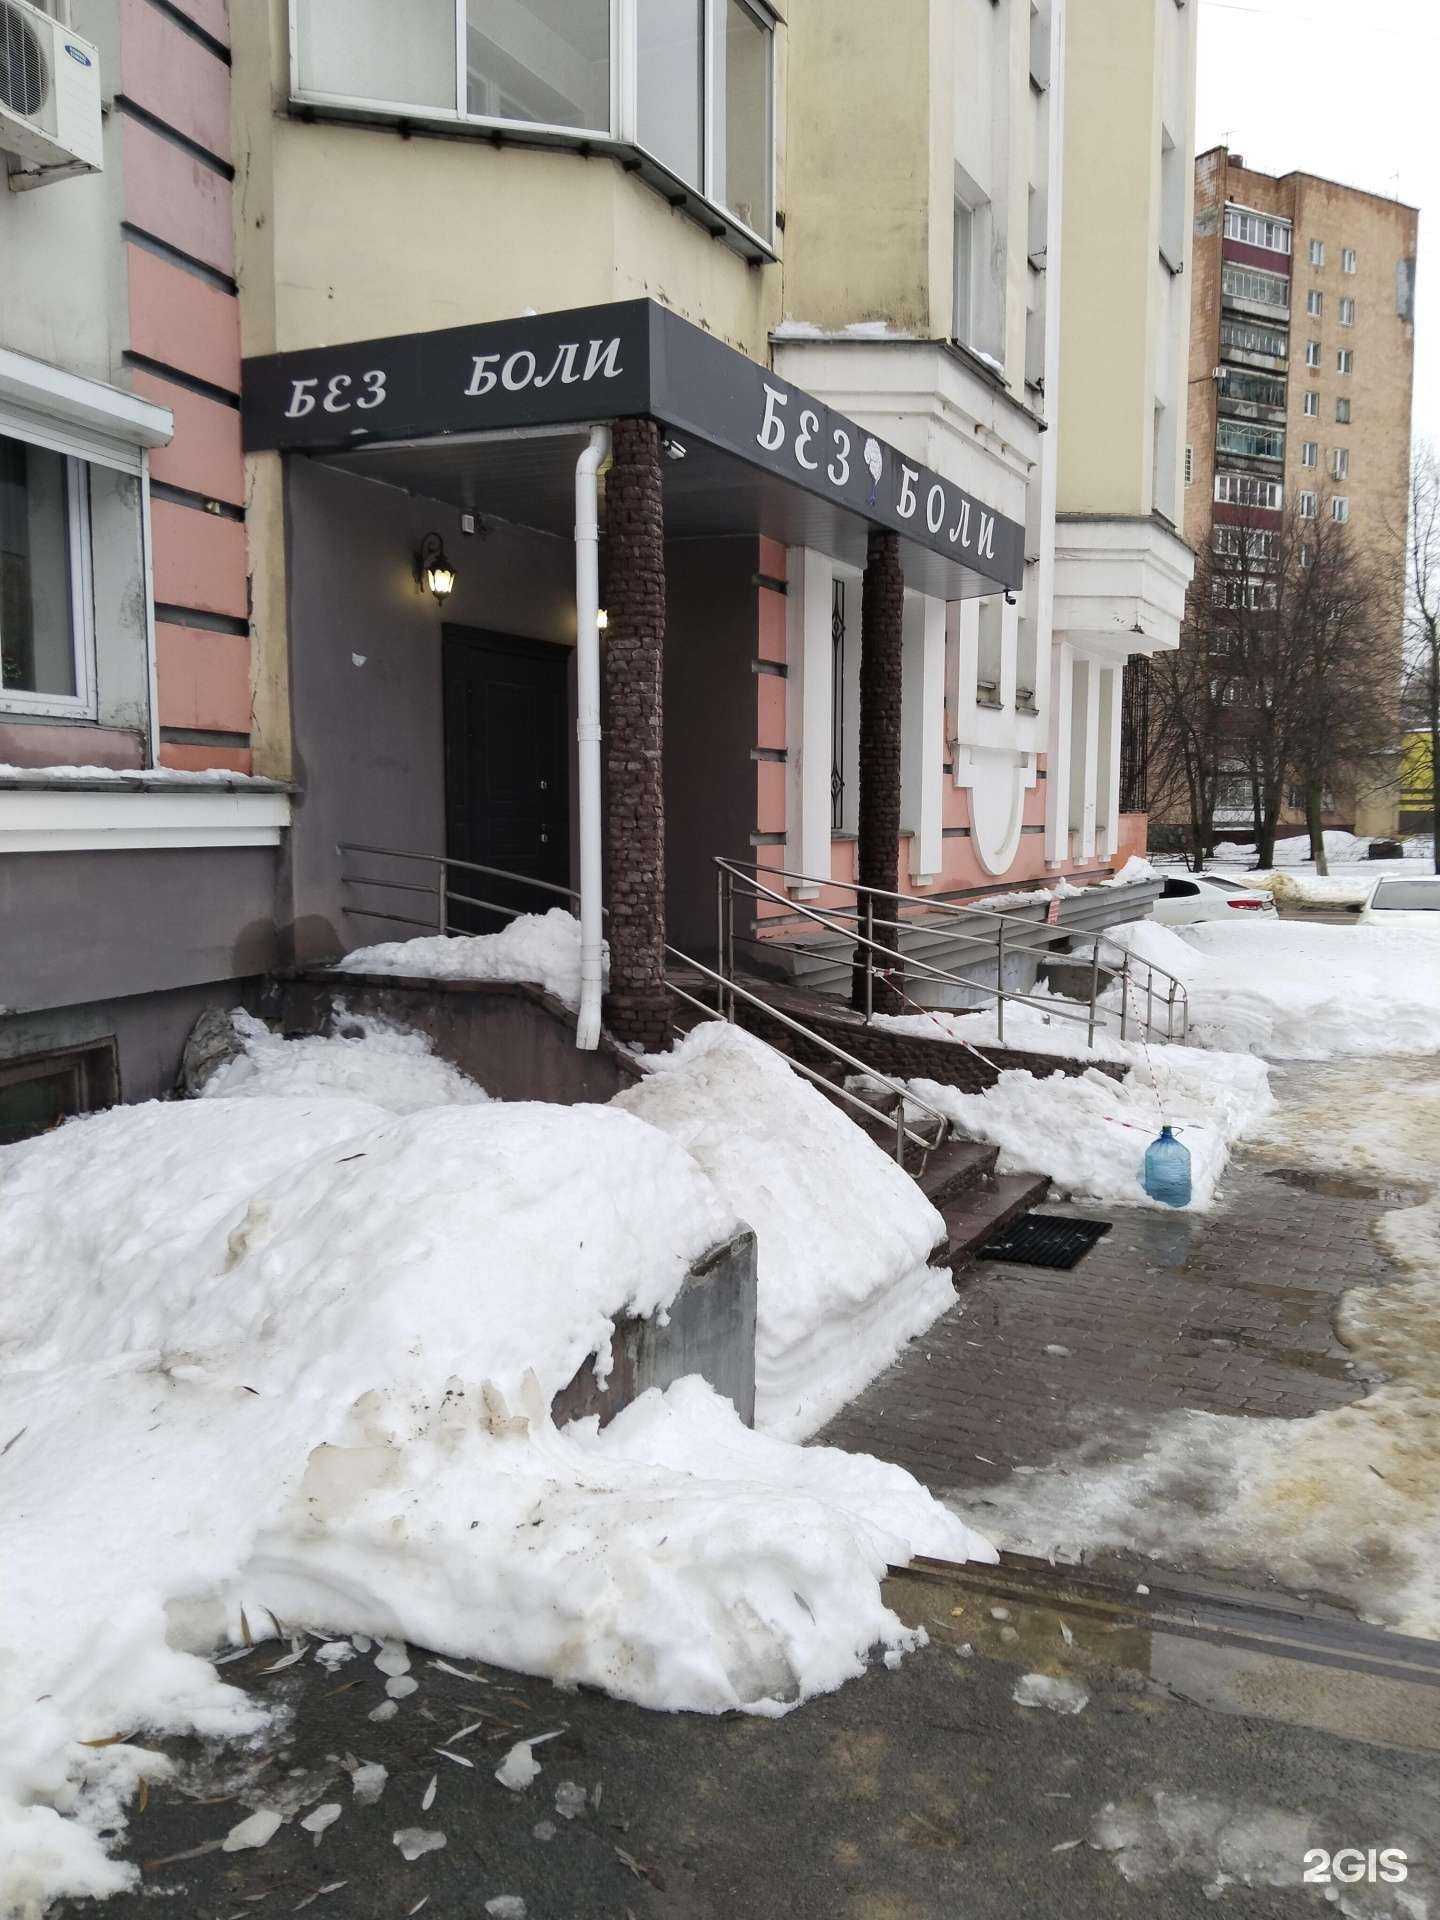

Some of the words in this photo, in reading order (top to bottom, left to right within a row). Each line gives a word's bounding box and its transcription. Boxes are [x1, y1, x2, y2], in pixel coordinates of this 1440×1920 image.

[284, 369, 387, 418] БЕЗ
[464, 337, 623, 396] БОЛИ
[756, 383, 851, 486] БЕЗ
[896, 464, 995, 559] БОЛИ
